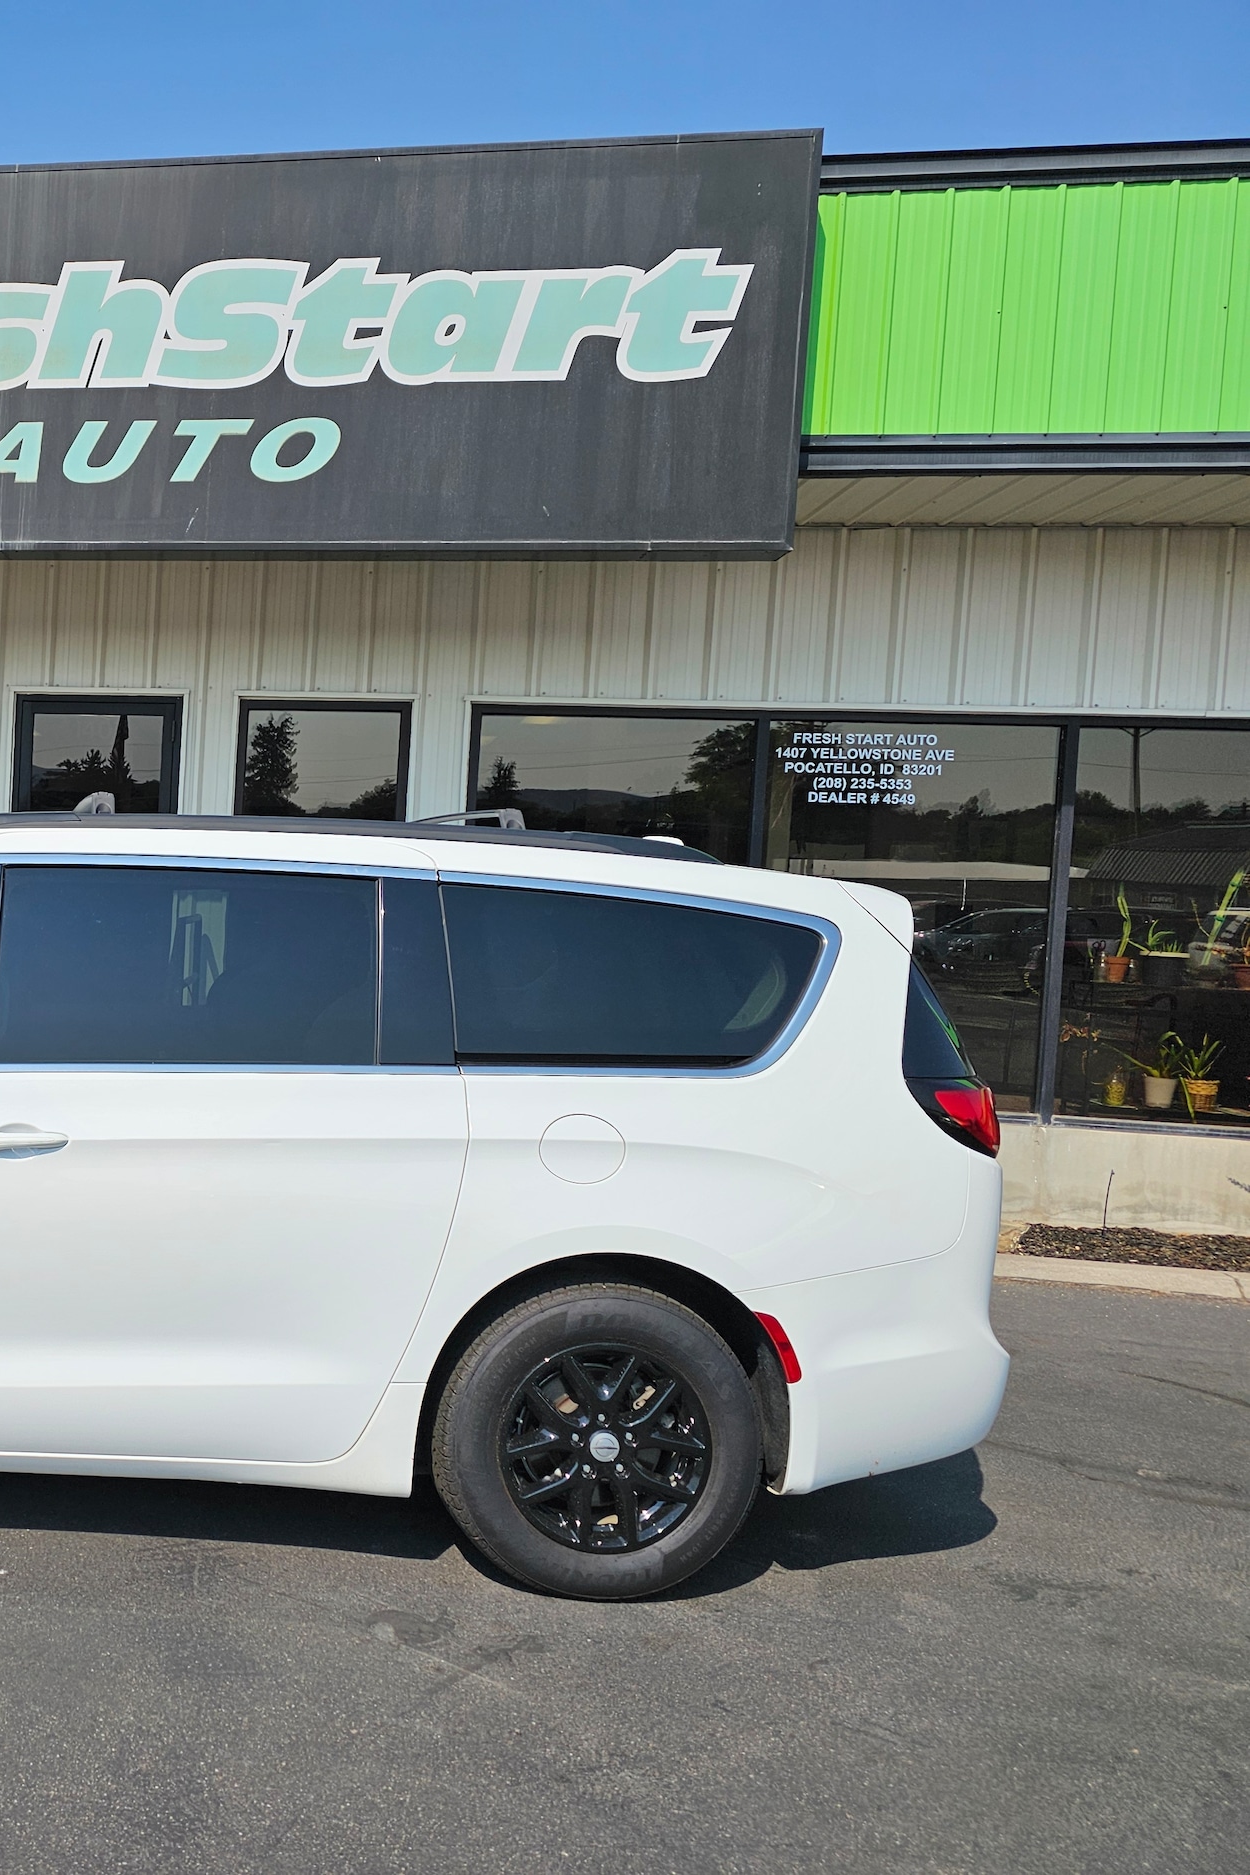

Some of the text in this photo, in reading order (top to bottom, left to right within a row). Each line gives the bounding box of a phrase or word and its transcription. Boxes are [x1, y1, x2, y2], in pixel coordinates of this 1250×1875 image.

[793, 733, 938, 745] FRESH START AUTO
[775, 748, 955, 761] 1407 YELLOWSTONE AVE
[784, 762, 942, 776] POCATELLO, ID 83201
[813, 777, 912, 791] (208) 235-5353
[808, 792, 915, 804] DEALER # 4549
